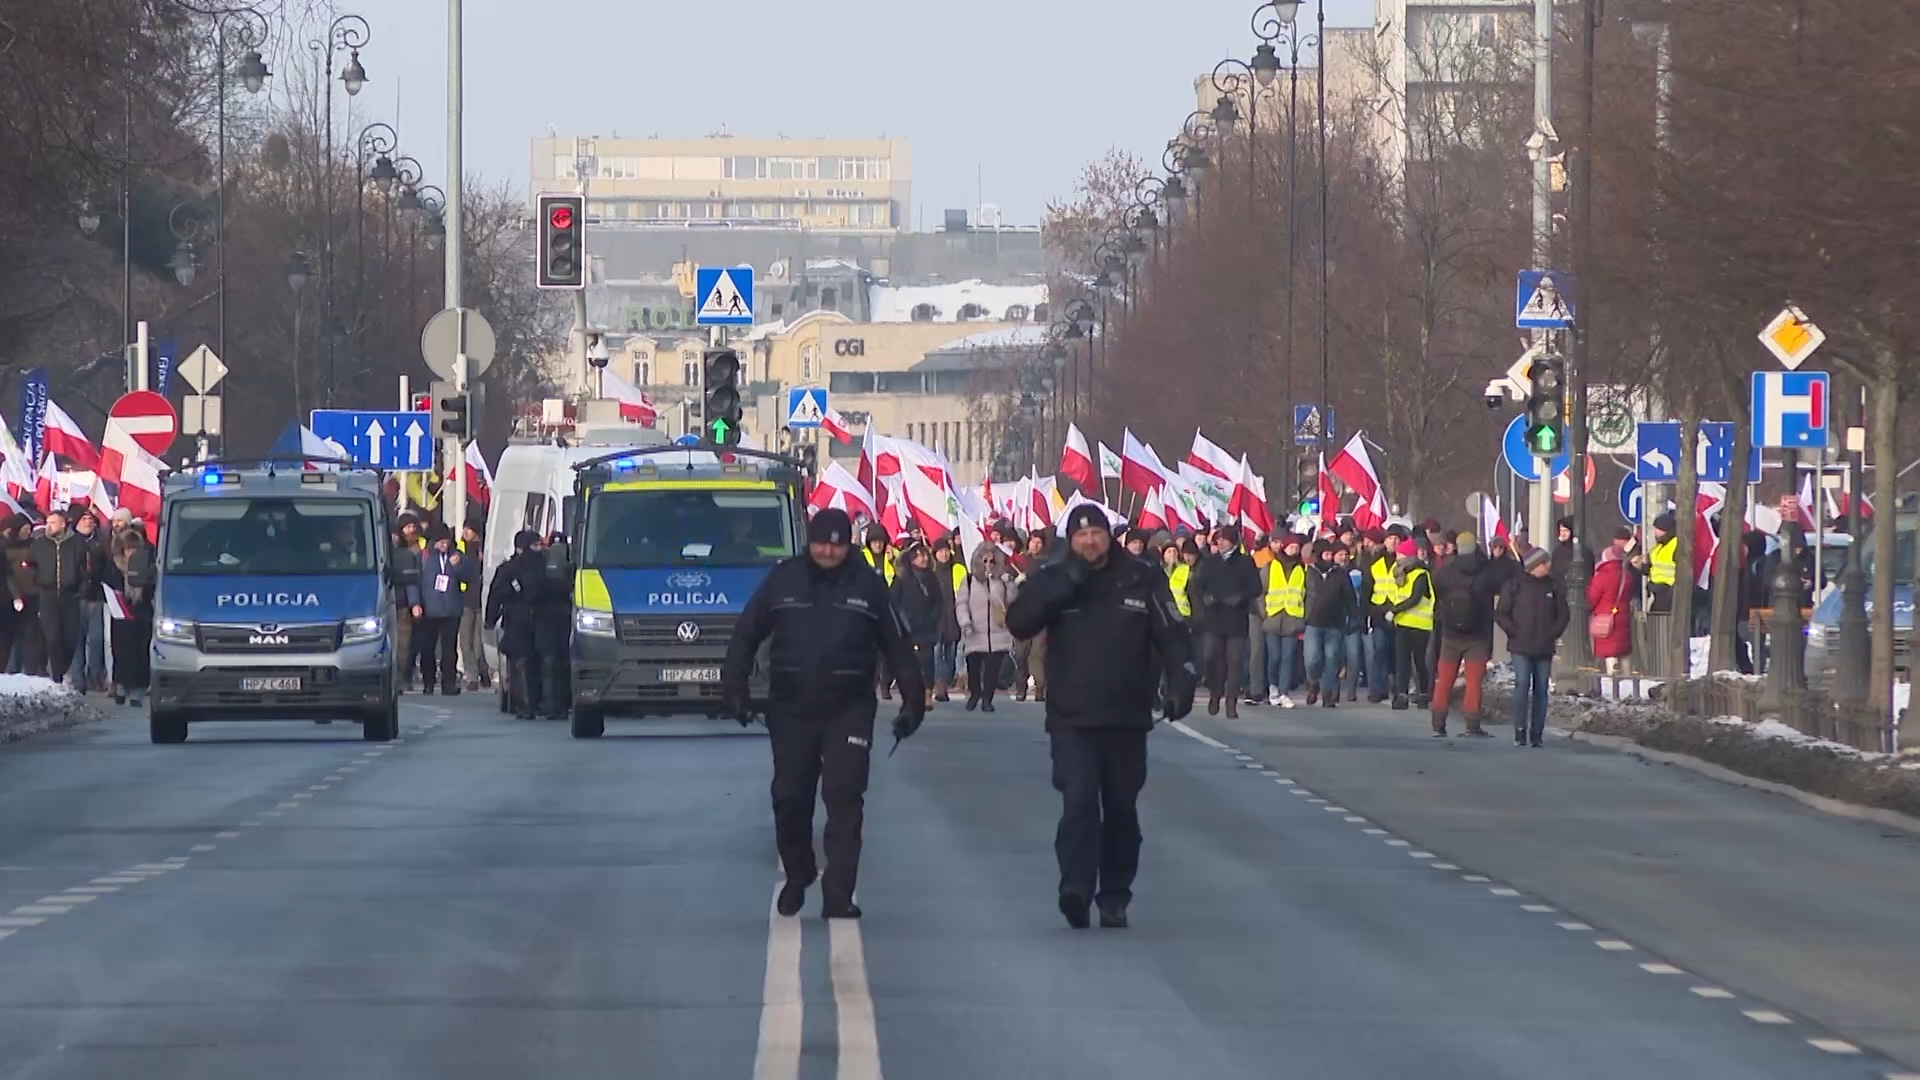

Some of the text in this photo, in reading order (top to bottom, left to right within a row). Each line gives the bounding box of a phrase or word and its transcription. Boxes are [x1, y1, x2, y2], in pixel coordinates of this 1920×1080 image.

[624, 305, 698, 330] ROL
[217, 592, 320, 607] POLICJA
[647, 592, 729, 606] POLICJA
[249, 635, 289, 644] MAN
